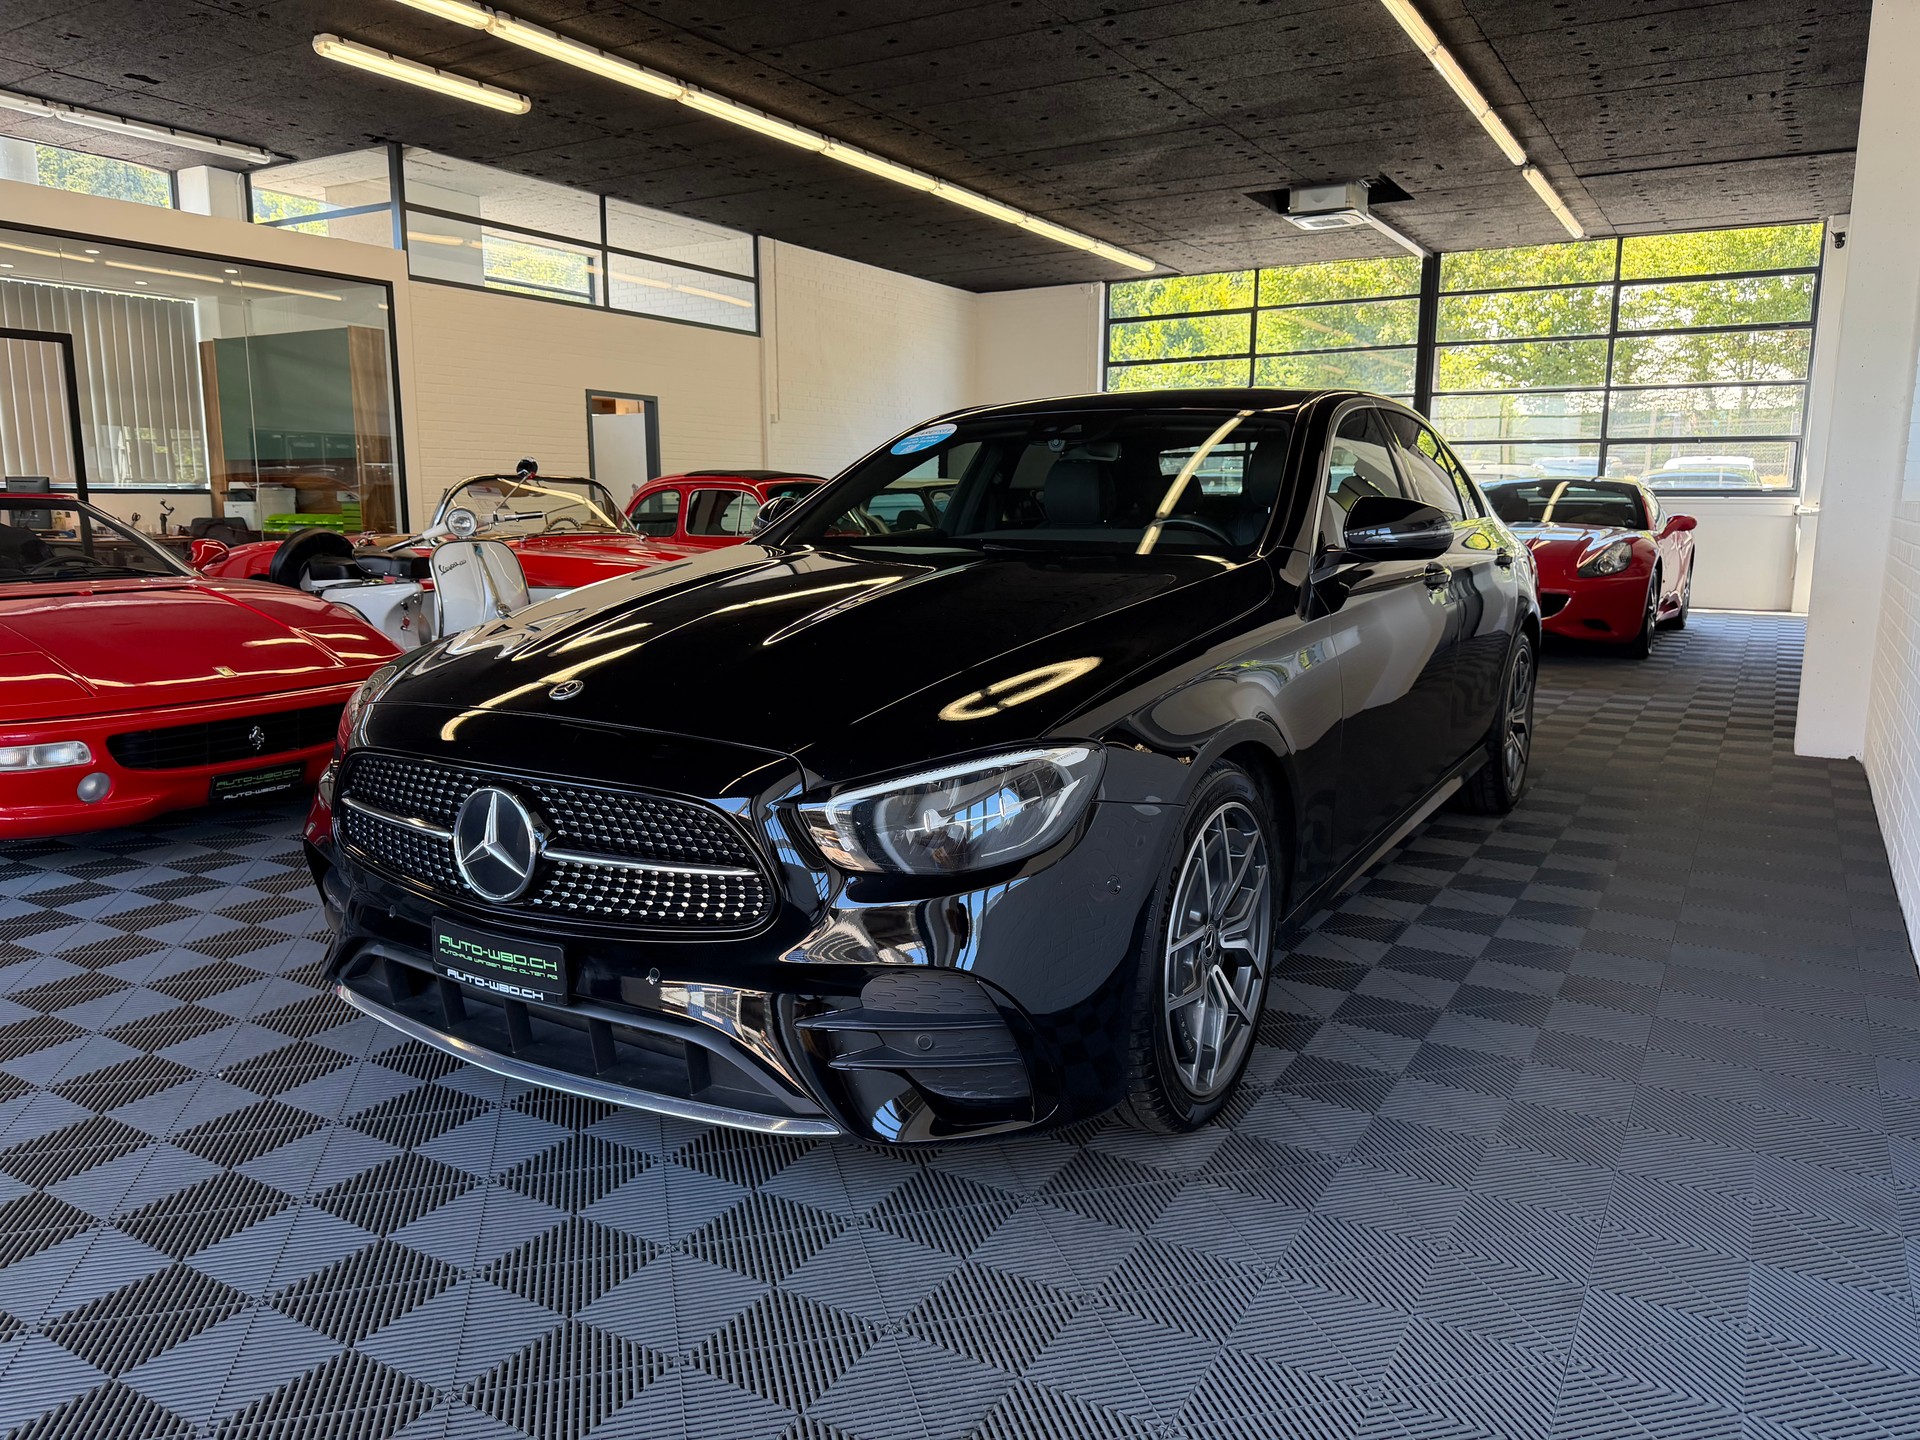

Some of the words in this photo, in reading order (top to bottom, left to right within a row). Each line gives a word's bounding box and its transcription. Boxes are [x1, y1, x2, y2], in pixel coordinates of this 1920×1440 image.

[438, 562, 459, 576] Vespa
[223, 783, 291, 800] AUTO-WBO.CH
[439, 934, 558, 971] AUTO-WBO.CH
[440, 948, 473, 962] AUTOHAUS
[474, 958, 501, 968] WANGEN
[519, 968, 545, 977] OLTEN
[447, 968, 544, 1001] AUTO-WBO.CH
